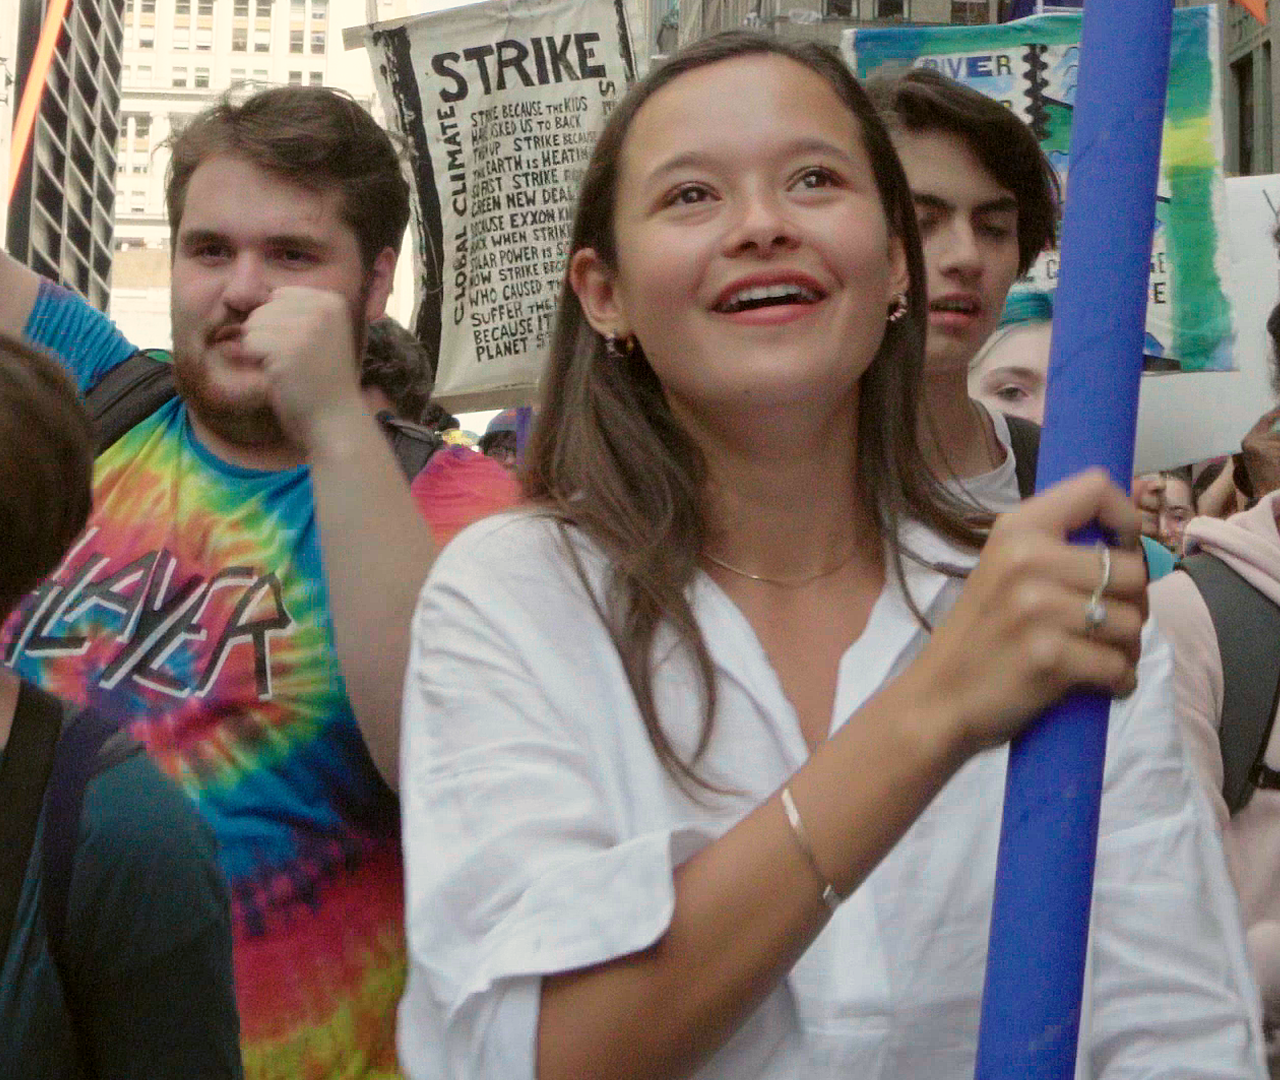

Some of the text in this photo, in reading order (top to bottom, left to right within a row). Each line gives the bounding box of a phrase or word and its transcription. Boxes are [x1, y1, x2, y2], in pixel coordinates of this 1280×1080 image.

[431, 32, 608, 103] STRIKE
[502, 100, 543, 119] BECAUSE
[546, 103, 563, 115] THE
[564, 96, 588, 113] KIDS
[520, 119, 533, 133] US
[537, 120, 551, 132] TO
[555, 115, 582, 130] BACK
[514, 134, 560, 152] STRIKE
[486, 154, 522, 176] EARTH
[527, 158, 538, 170] IS
[512, 168, 558, 190] STRIKE
[506, 189, 536, 209] NEW
[437, 105, 469, 326] GLOBAL CLIMATE
[510, 209, 555, 229] EXXON
[491, 231, 527, 249] WHEN
[500, 245, 539, 267] POWER
[498, 263, 538, 282] STRIKE
[470, 288, 498, 308] WHO
[503, 279, 542, 301] CAUSED
[471, 301, 523, 328] SUFFER
[473, 317, 533, 346] BECAUSE
[538, 313, 553, 332] IT
[476, 336, 528, 363] PLANET
